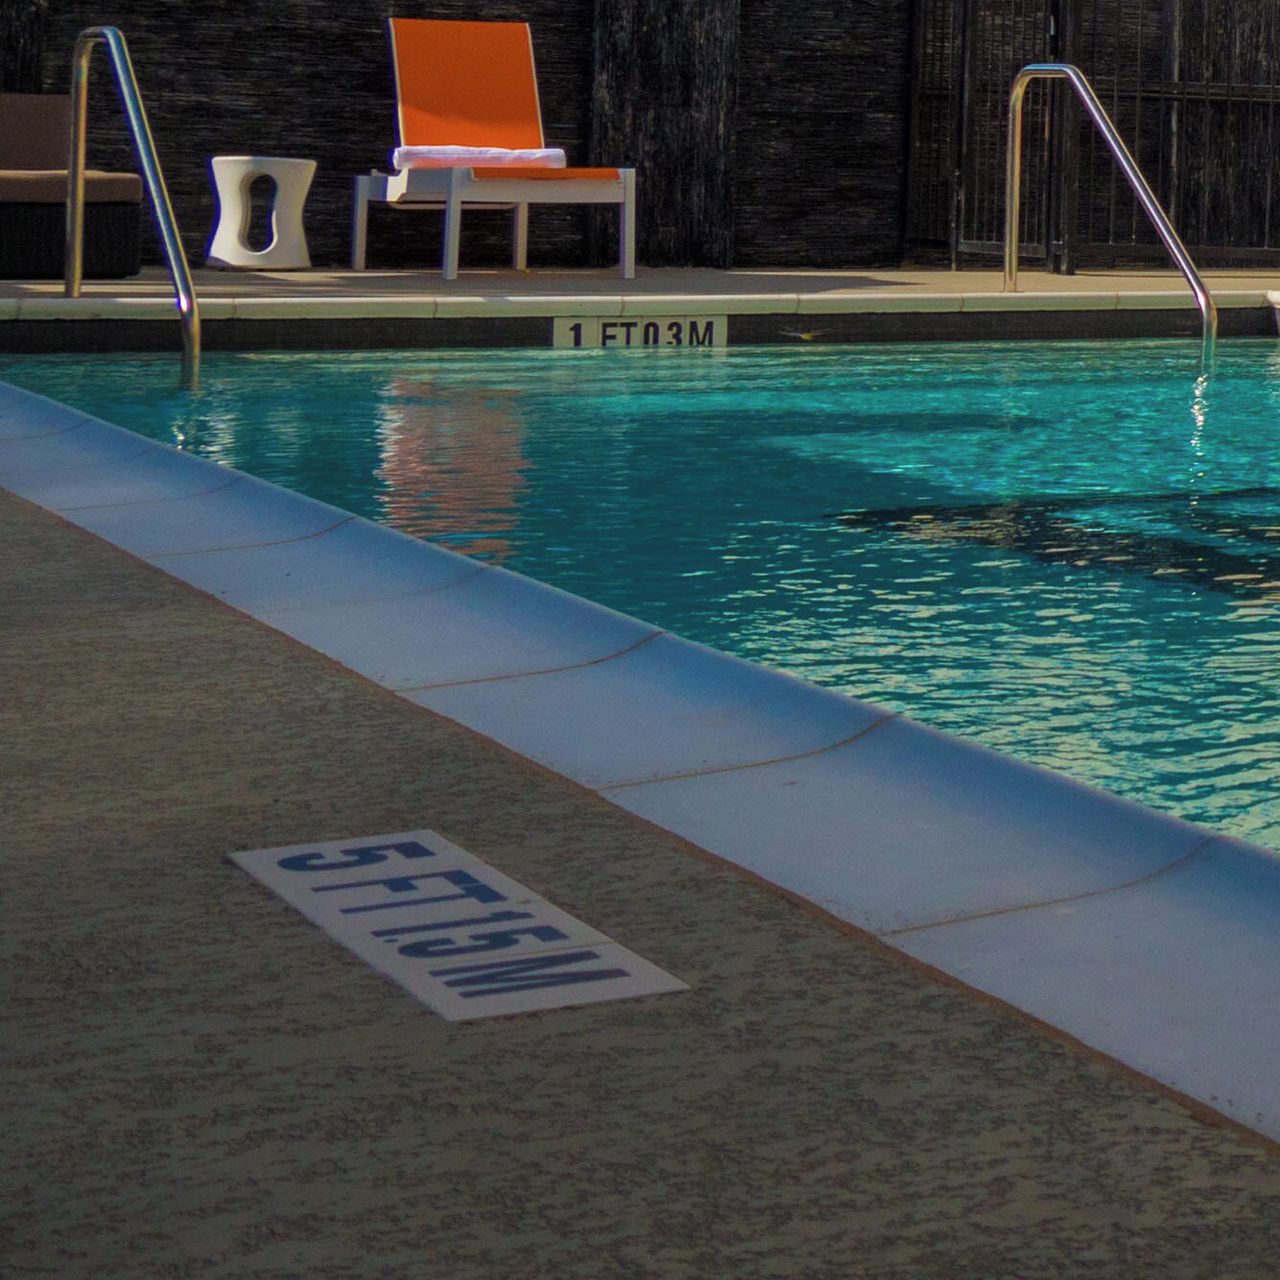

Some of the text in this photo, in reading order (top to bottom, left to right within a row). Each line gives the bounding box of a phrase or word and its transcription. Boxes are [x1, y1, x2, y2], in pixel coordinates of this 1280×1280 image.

[569, 322, 581, 346] 1
[602, 322, 637, 346] FT
[689, 321, 713, 346] M
[277, 841, 436, 873] 5
[310, 870, 508, 915] FT
[428, 950, 632, 1000] M
